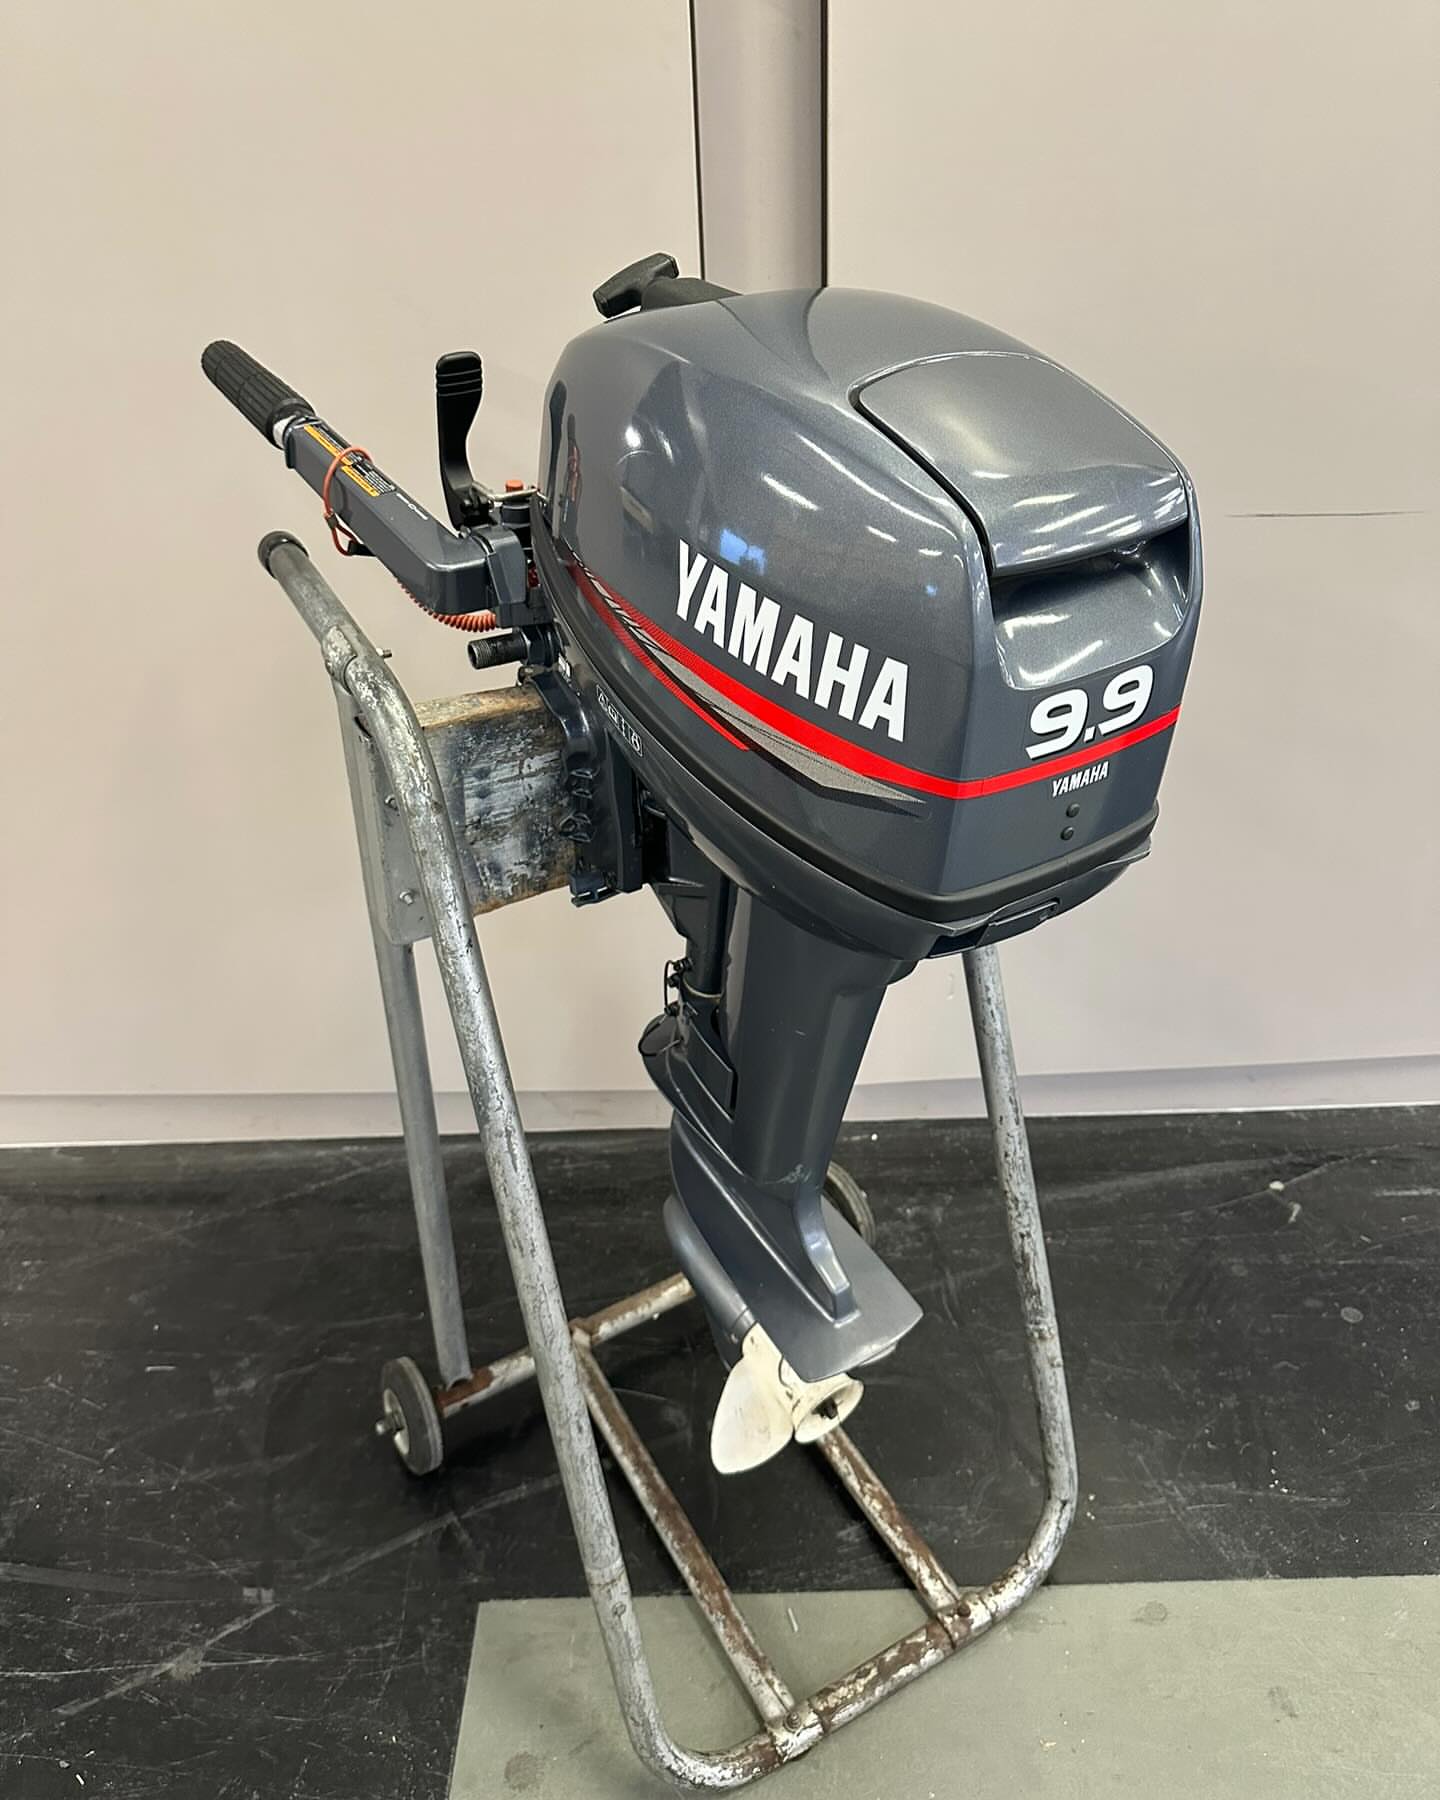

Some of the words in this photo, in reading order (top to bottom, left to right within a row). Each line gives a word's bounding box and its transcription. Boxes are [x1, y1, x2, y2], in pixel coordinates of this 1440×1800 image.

[677, 538, 909, 743] YAMAHA
[1025, 664, 1154, 760] 9.9
[1052, 761, 1110, 798] YAMAHA
